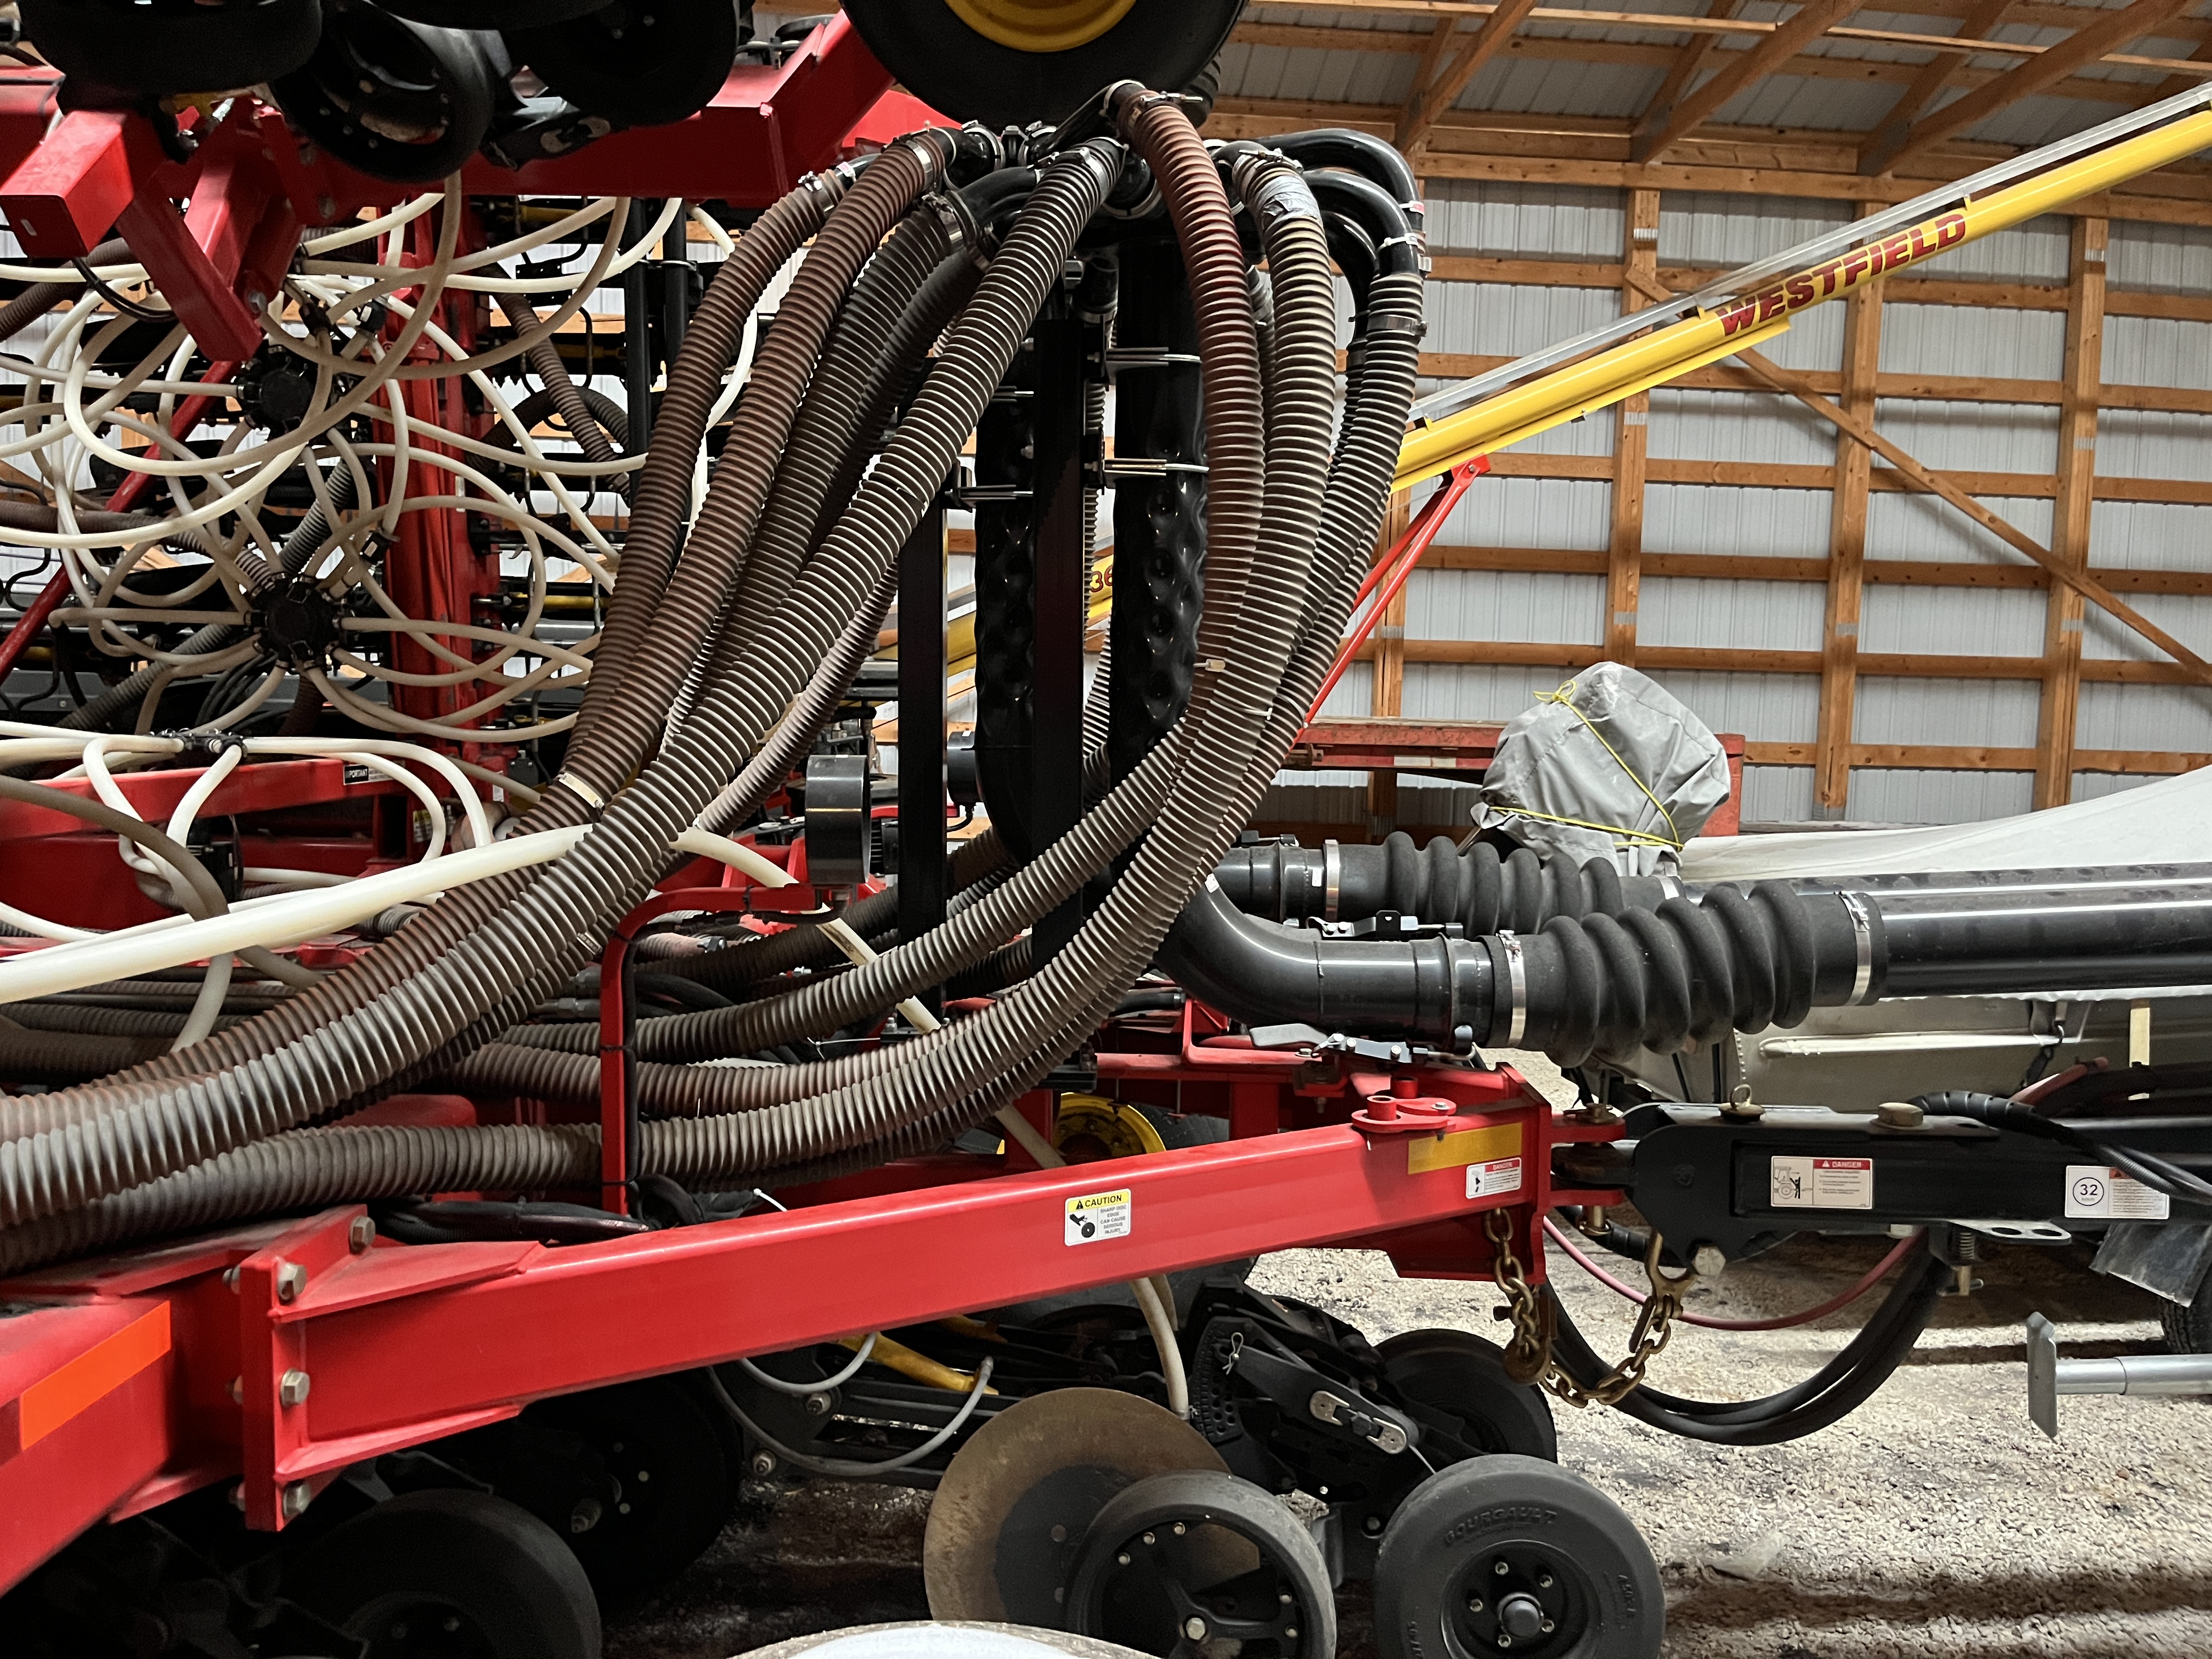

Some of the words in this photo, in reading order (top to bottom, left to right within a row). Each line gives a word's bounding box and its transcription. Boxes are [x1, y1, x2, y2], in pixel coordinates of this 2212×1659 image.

[1715, 214, 1966, 336] WESTFIELD
[345, 769, 368, 778] PORTANT
[1492, 1162, 1513, 1170] DANGER
[2080, 1184, 2098, 1195] 32
[1085, 1194, 1121, 1207] CAUTION
[1444, 1506, 1558, 1545] BOURGAULT
